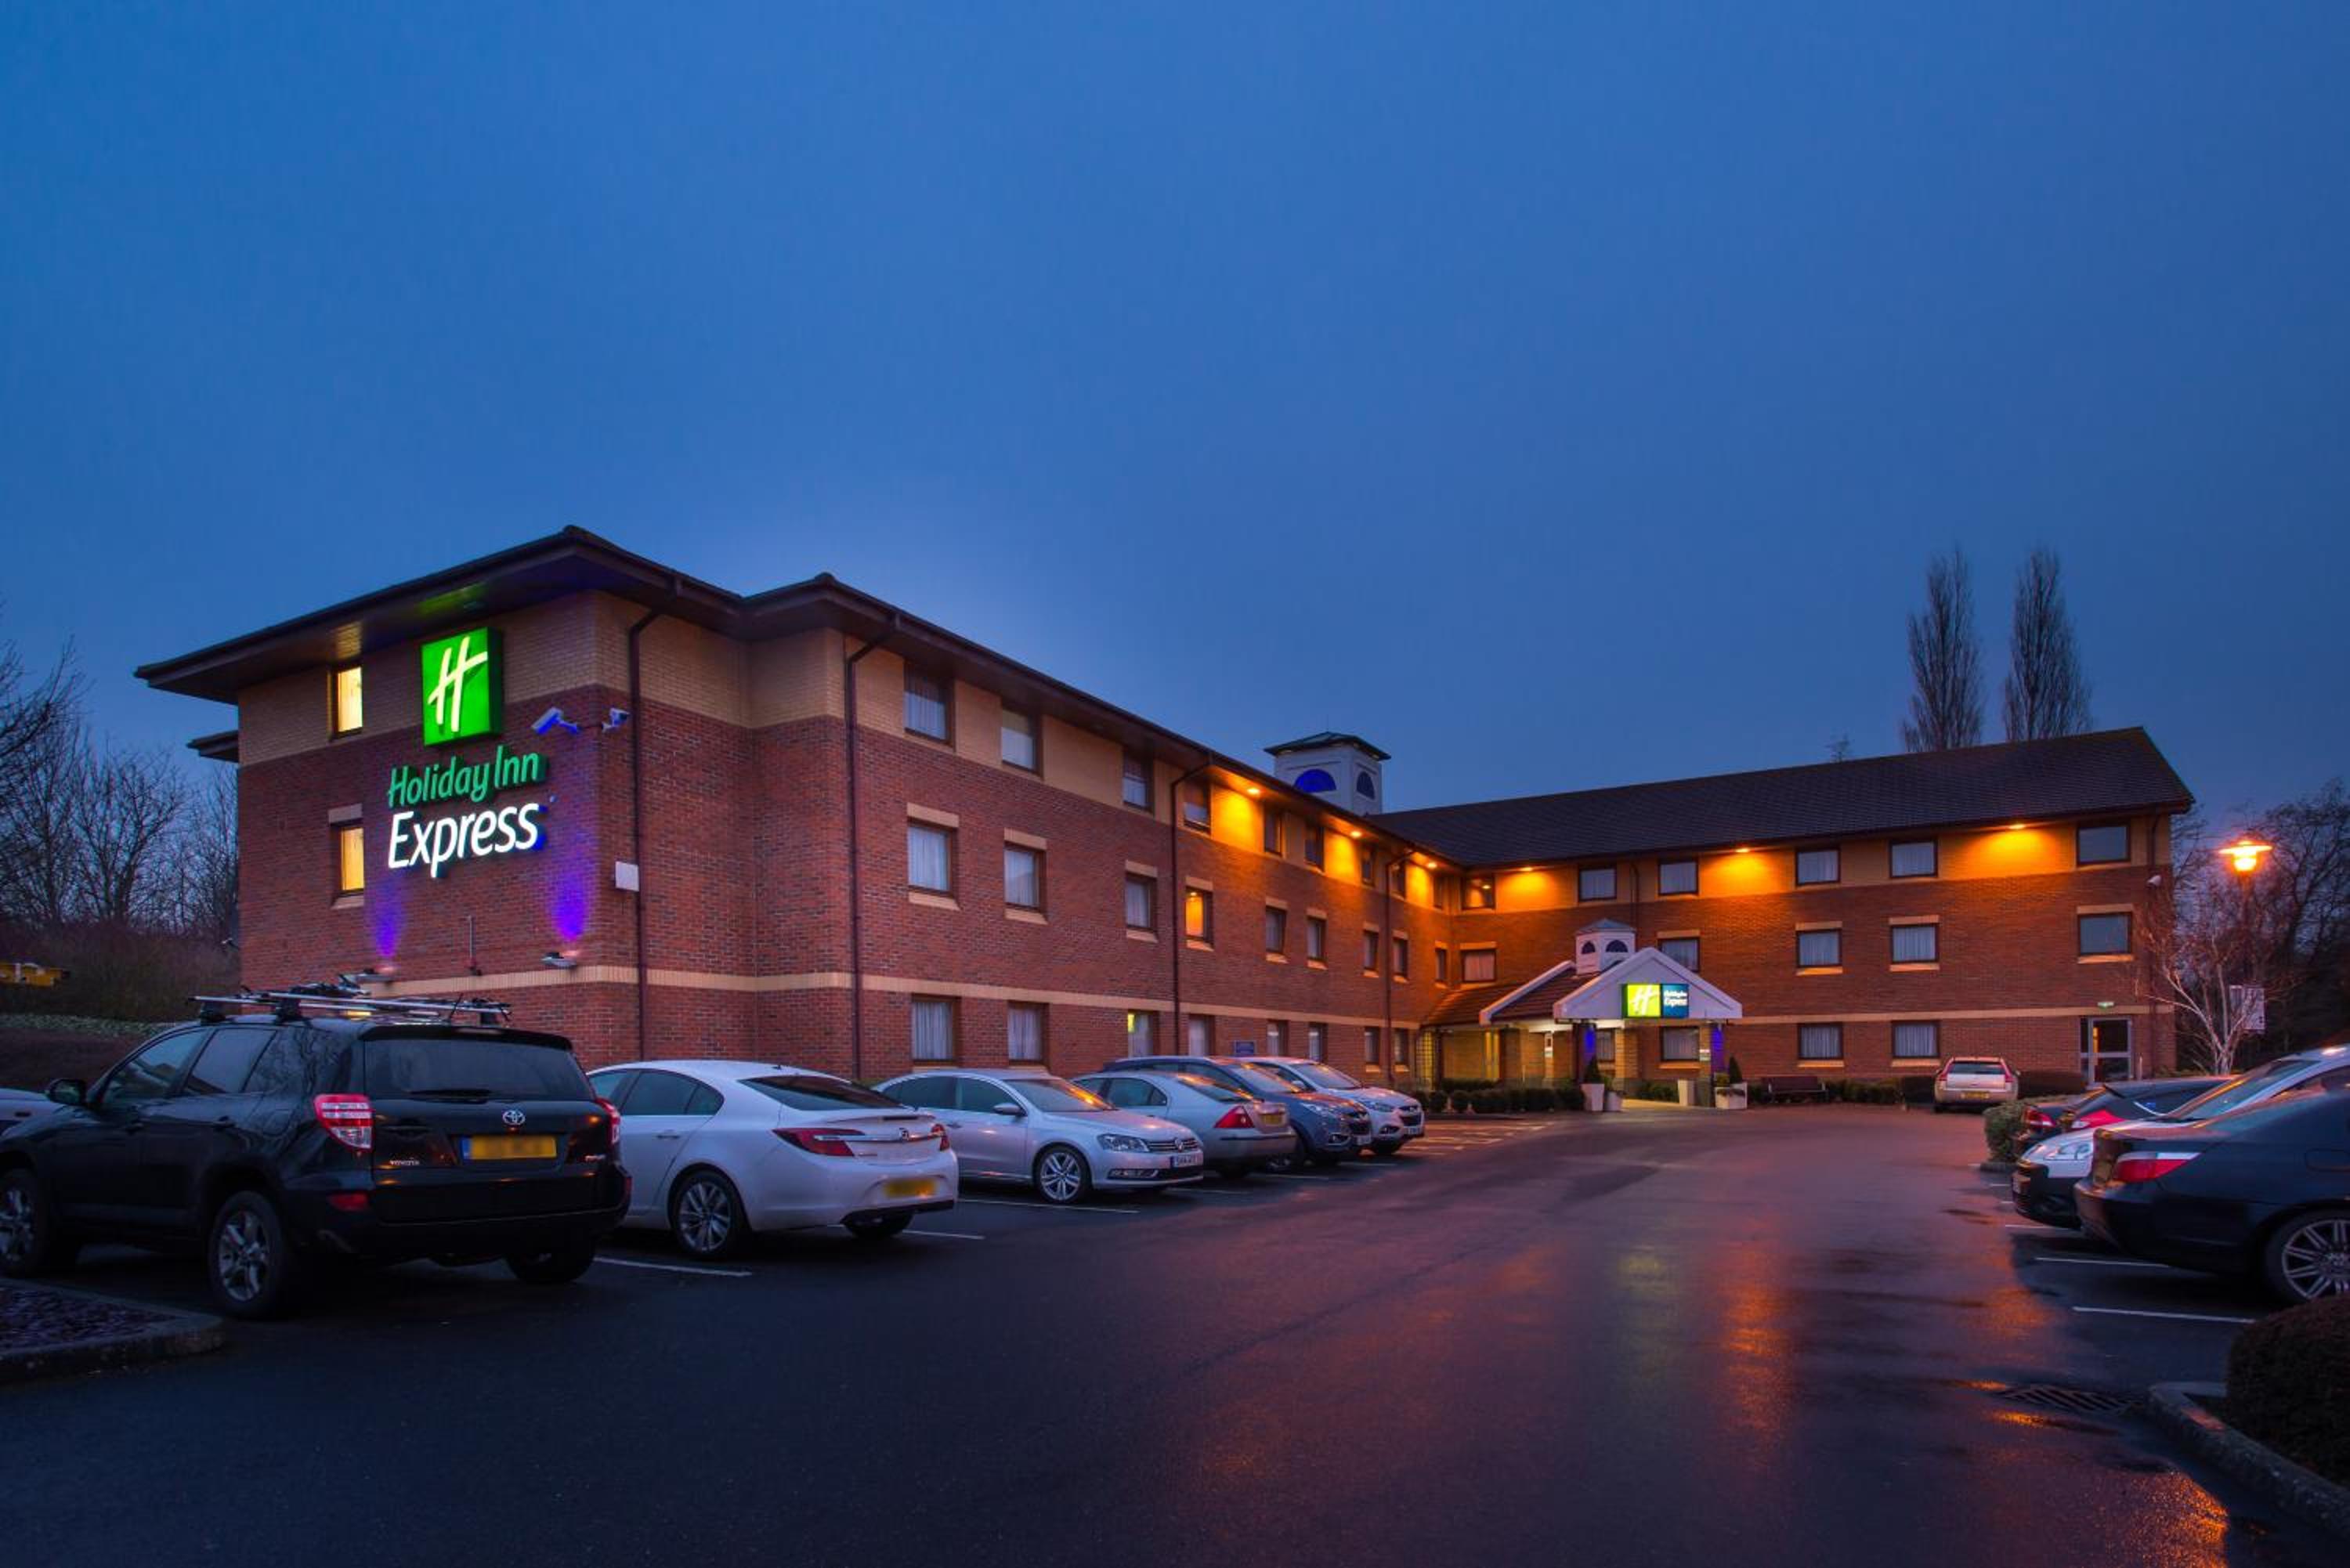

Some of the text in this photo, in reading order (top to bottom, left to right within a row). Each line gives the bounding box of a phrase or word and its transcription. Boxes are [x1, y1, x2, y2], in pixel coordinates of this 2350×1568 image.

[387, 745, 539, 808] Holiday Inn
[388, 803, 540, 878] Express
